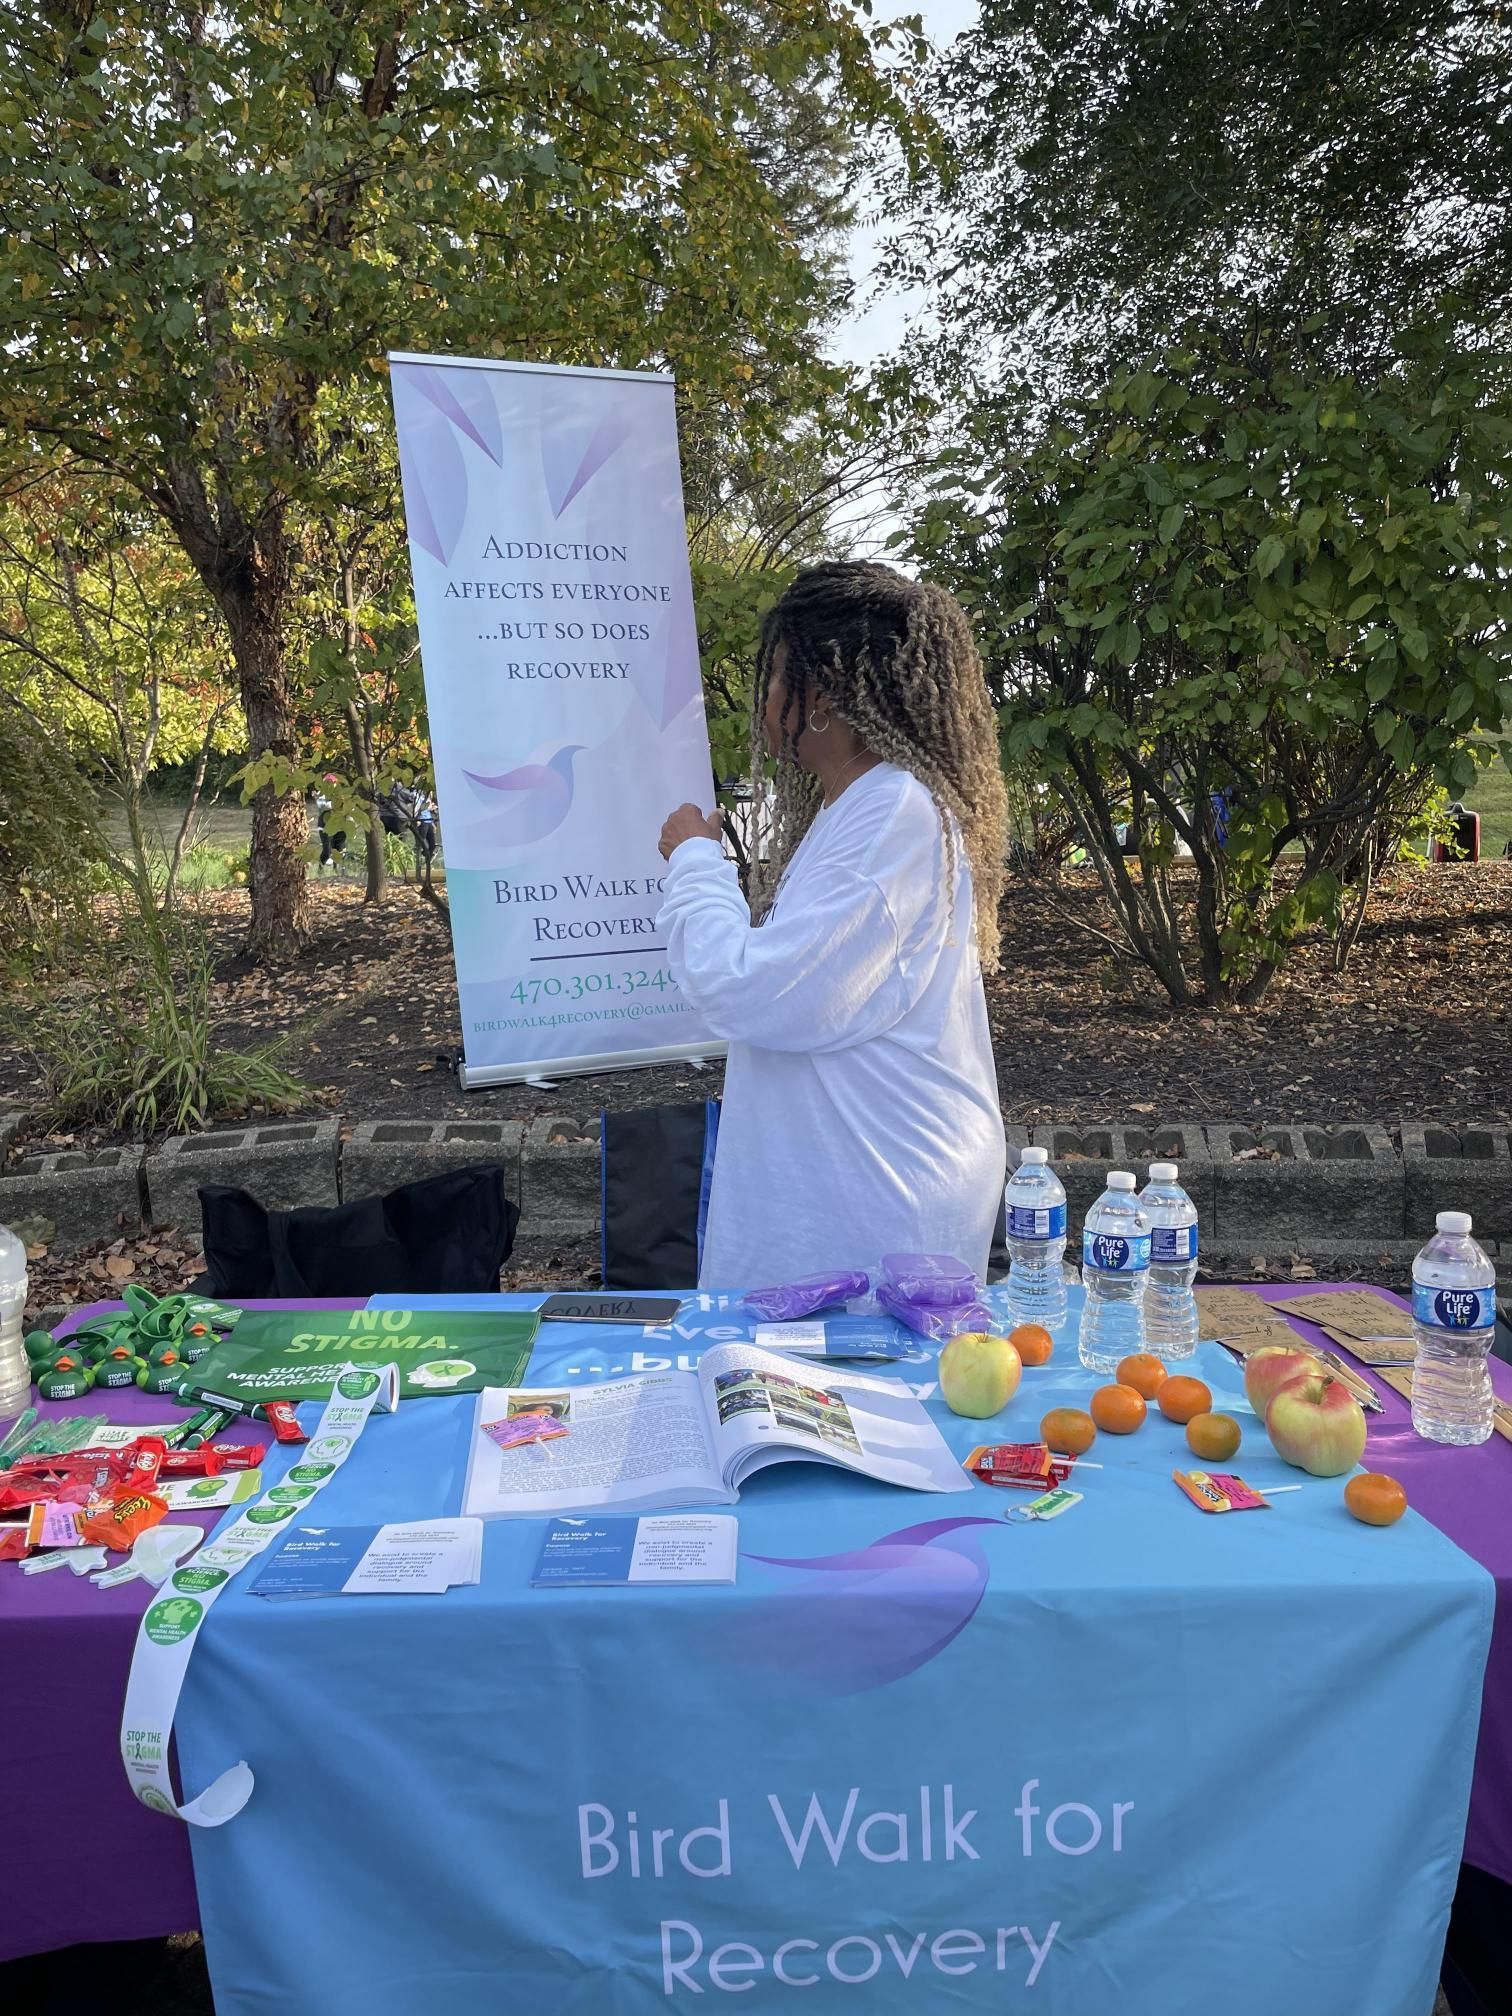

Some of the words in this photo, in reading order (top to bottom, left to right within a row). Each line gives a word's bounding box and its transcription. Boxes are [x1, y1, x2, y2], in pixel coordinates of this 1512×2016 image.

[481, 535, 628, 562] ADDICTION
[444, 581, 544, 599] AFFECTS
[551, 583, 672, 602] EVERYONE
[554, 622, 584, 640] SO
[592, 623, 650, 640] DOES
[505, 662, 631, 680] RECOVERY
[492, 879, 558, 905] BIRD
[562, 874, 639, 899] WALK
[645, 877, 668, 895] FO
[532, 916, 657, 942] RECOVERY
[473, 1002, 696, 1032] BIRDWALK4RECOVERY@GMAIL.
[1098, 1236, 1124, 1249] Pure
[1100, 1246, 1121, 1260] Life
[1442, 1291, 1474, 1303] Pure
[1446, 1302, 1471, 1317] Life
[348, 1310, 412, 1331] NO
[284, 1333, 460, 1353] STIGMA.
[227, 1371, 309, 1382] MENTAL
[310, 1369, 343, 1378] HE
[267, 1363, 345, 1374] SUPPOR
[238, 1375, 339, 1388] AWARENE
[126, 1731, 146, 1742] STOP
[147, 1732, 162, 1743] THE
[579, 1798, 732, 1879] Bird
[768, 1784, 980, 1870] Walk
[1014, 1779, 1134, 1857] for
[660, 1919, 1061, 1995] Recovery
